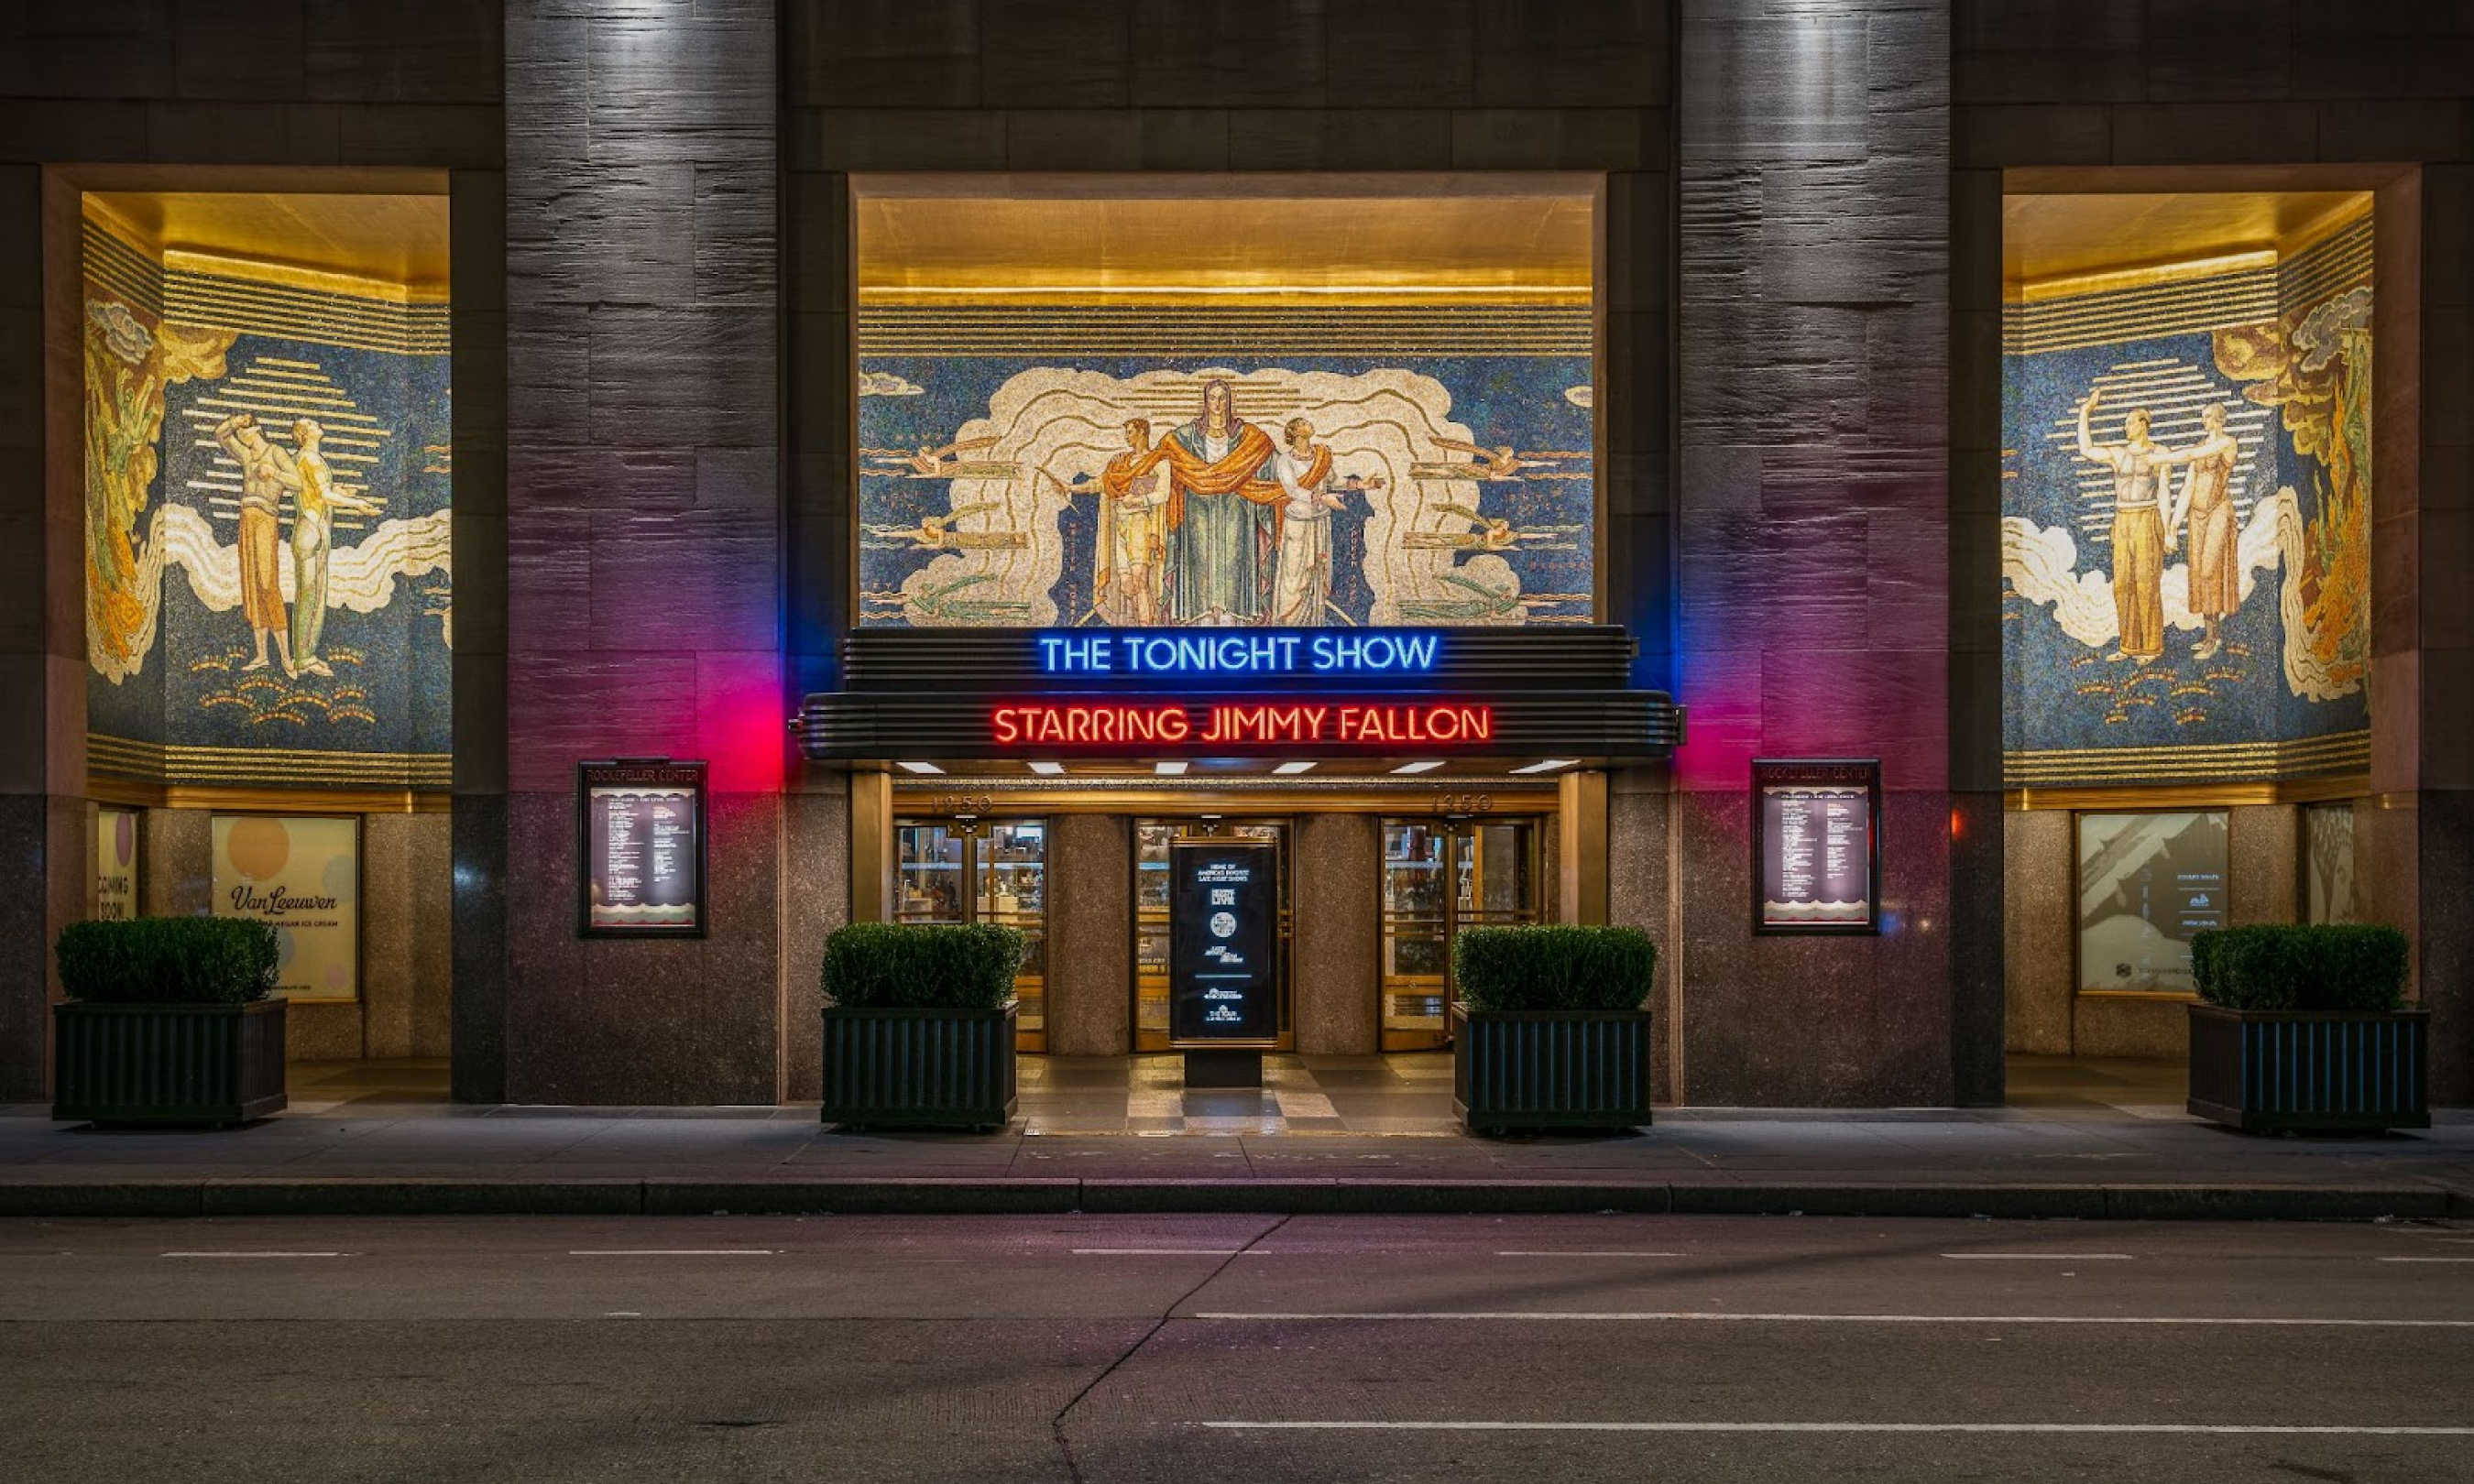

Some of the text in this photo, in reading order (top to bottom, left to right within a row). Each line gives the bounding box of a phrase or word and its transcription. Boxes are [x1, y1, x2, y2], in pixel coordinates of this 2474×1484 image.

[1041, 636, 1437, 671] THE TONIGHT SHOW
[992, 706, 1489, 742] STARRING JIMMY FALLON
[587, 769, 699, 782] ROCKEFELLER CENTER
[932, 795, 992, 812] 1250
[1432, 793, 1493, 812] 1250
[264, 885, 337, 915] Leeuwen
